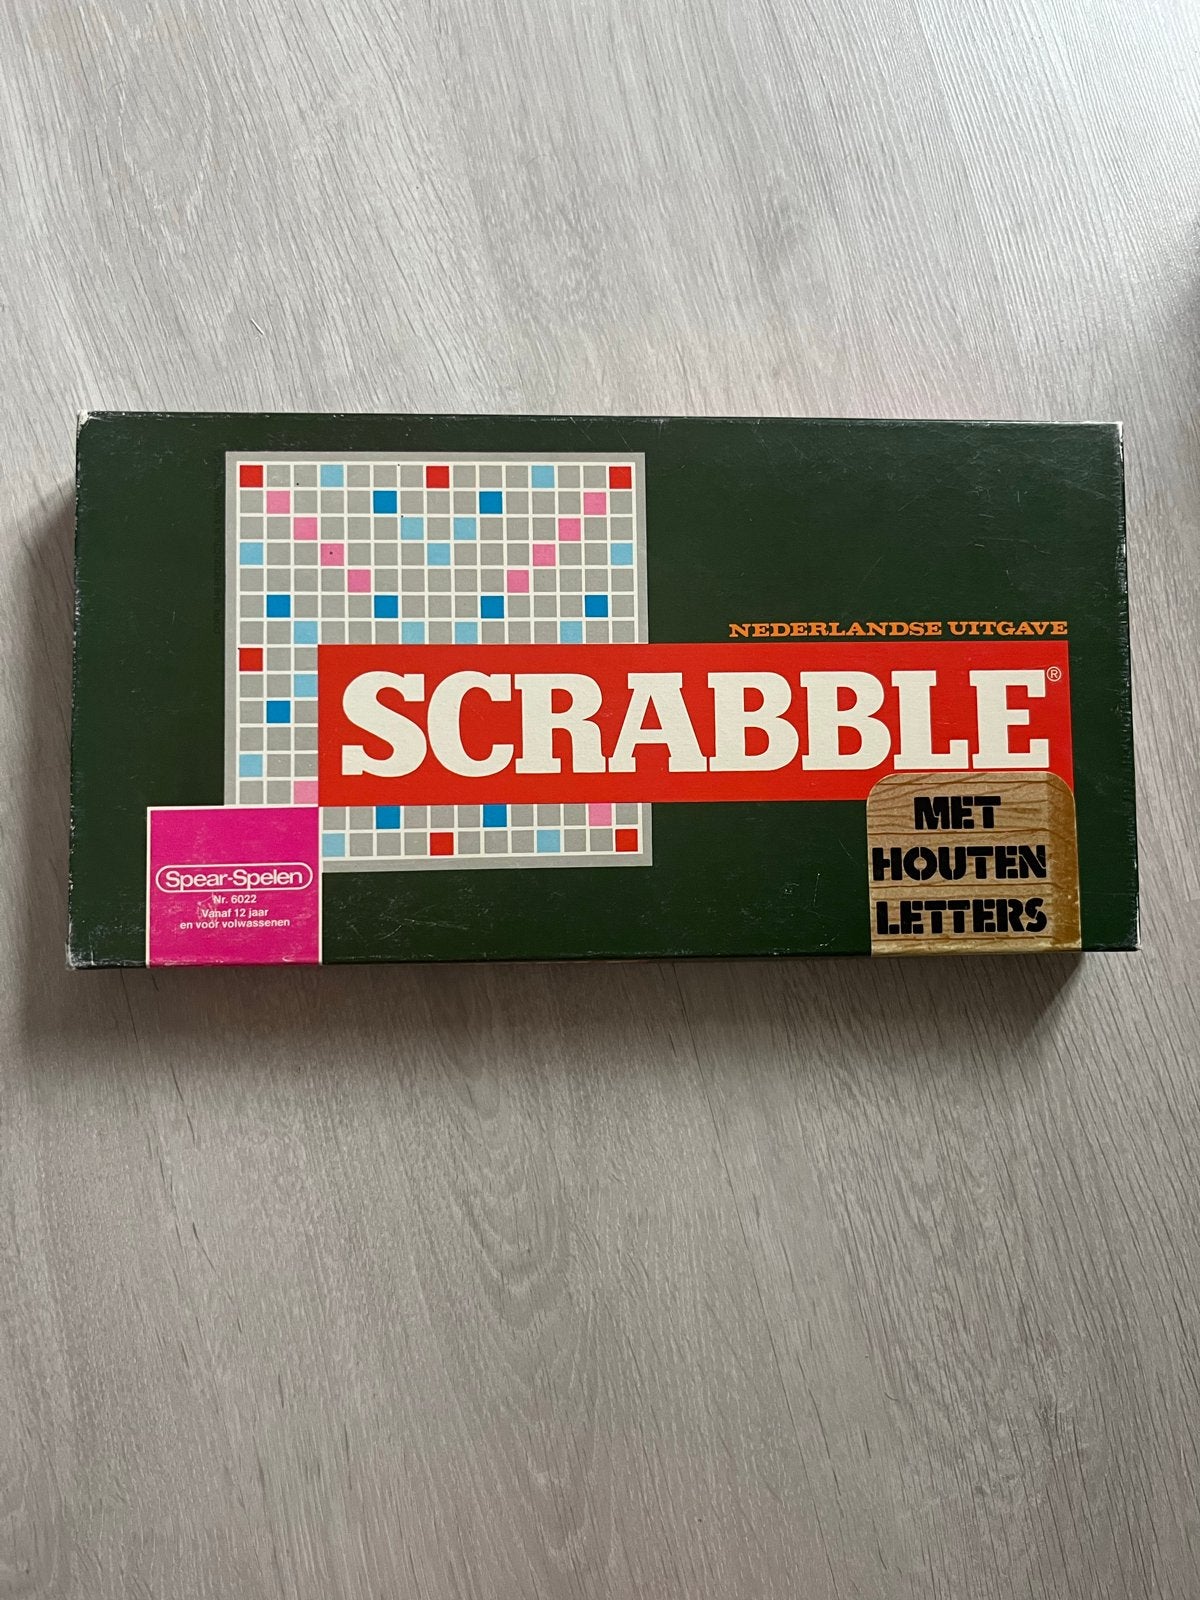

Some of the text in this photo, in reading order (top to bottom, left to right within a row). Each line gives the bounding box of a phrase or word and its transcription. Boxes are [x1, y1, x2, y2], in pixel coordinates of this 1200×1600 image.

[729, 621, 1067, 637] NEDERLANDSE UITGAVE
[914, 796, 1001, 829] MET
[873, 845, 1046, 880] HOUTEN
[165, 869, 303, 891] Spear-Spelen
[213, 894, 257, 904] Nr. 6022
[201, 907, 269, 918] Vanaf 12 jaar
[877, 898, 1047, 934] LETTERS
[179, 921, 193, 930] en
[221, 917, 291, 928] volwassenen
